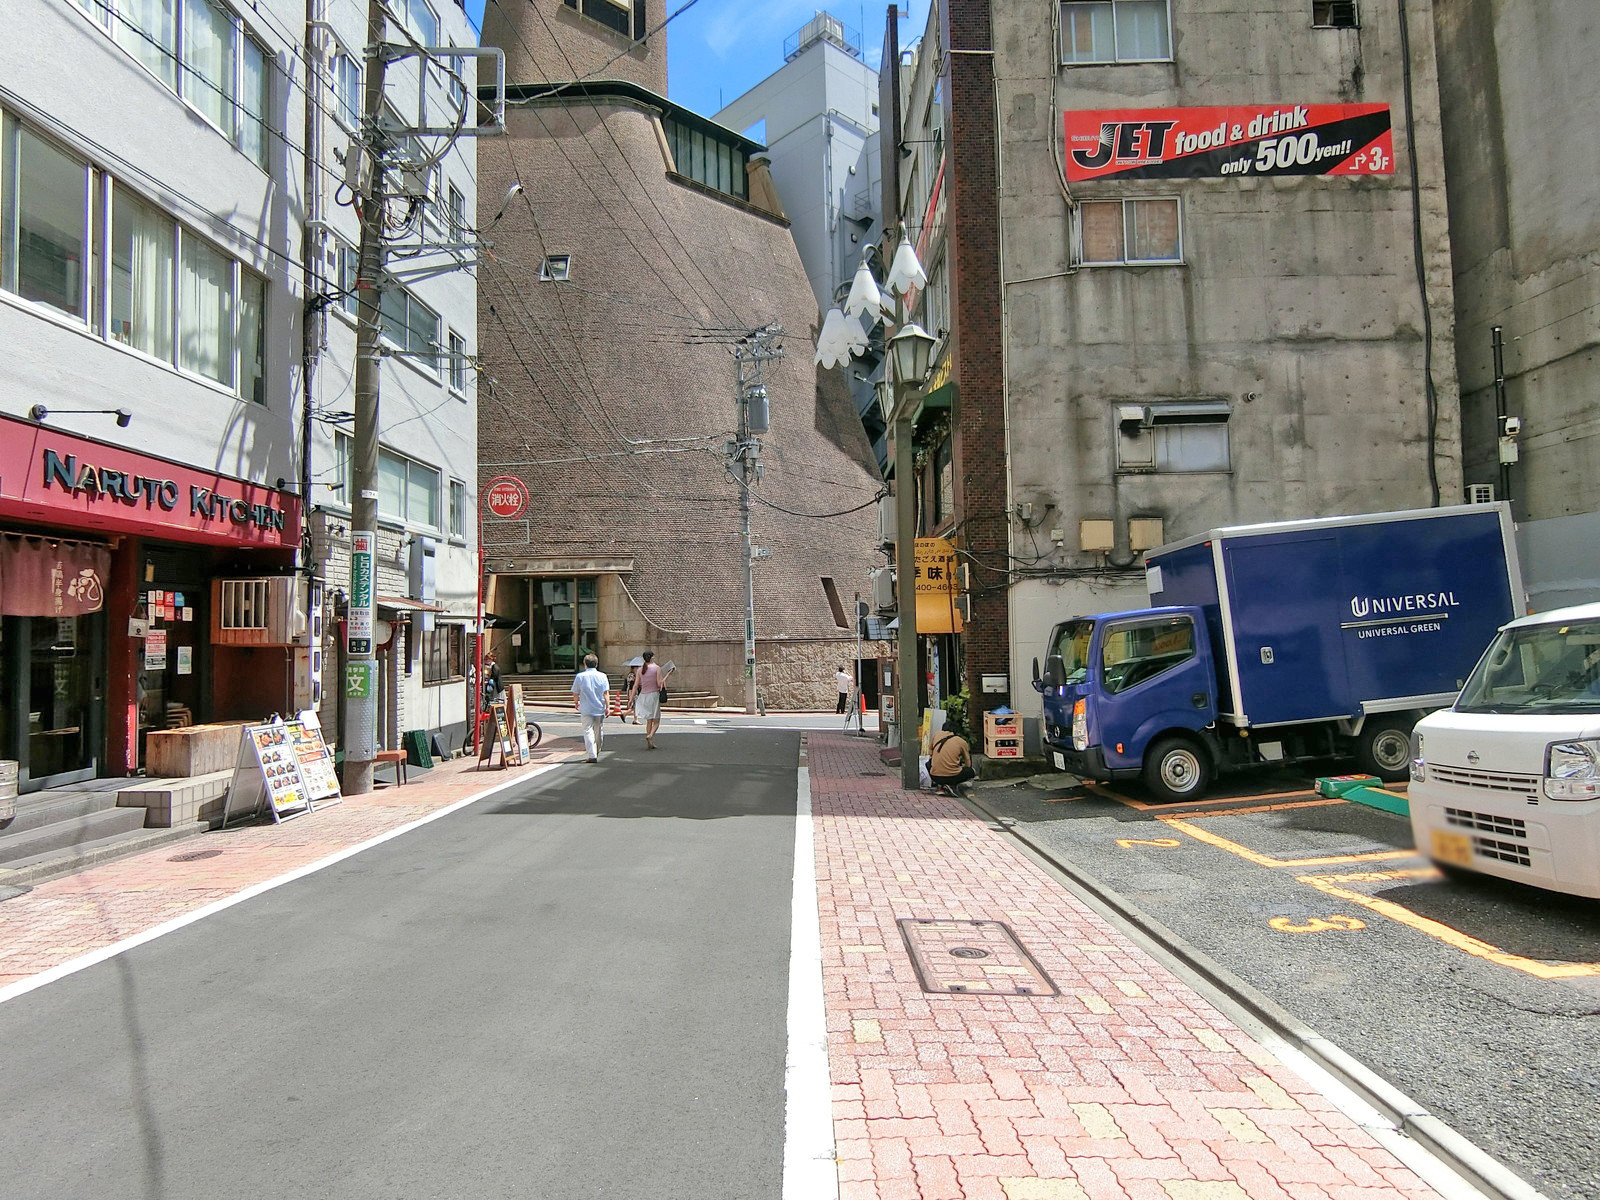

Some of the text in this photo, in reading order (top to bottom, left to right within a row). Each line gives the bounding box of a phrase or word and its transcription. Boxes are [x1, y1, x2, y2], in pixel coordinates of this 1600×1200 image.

[1175, 106, 1308, 155] food & drink
[1072, 121, 1179, 169] JET
[1221, 157, 1252, 175] only
[1369, 147, 1389, 171] 3F
[44, 448, 285, 531] NARUTO KITCHEN
[492, 493, 519, 506] 消火栓
[1351, 591, 1460, 617] UNIVERSAL
[1358, 622, 1441, 639] UNIVERSAL GREEN
